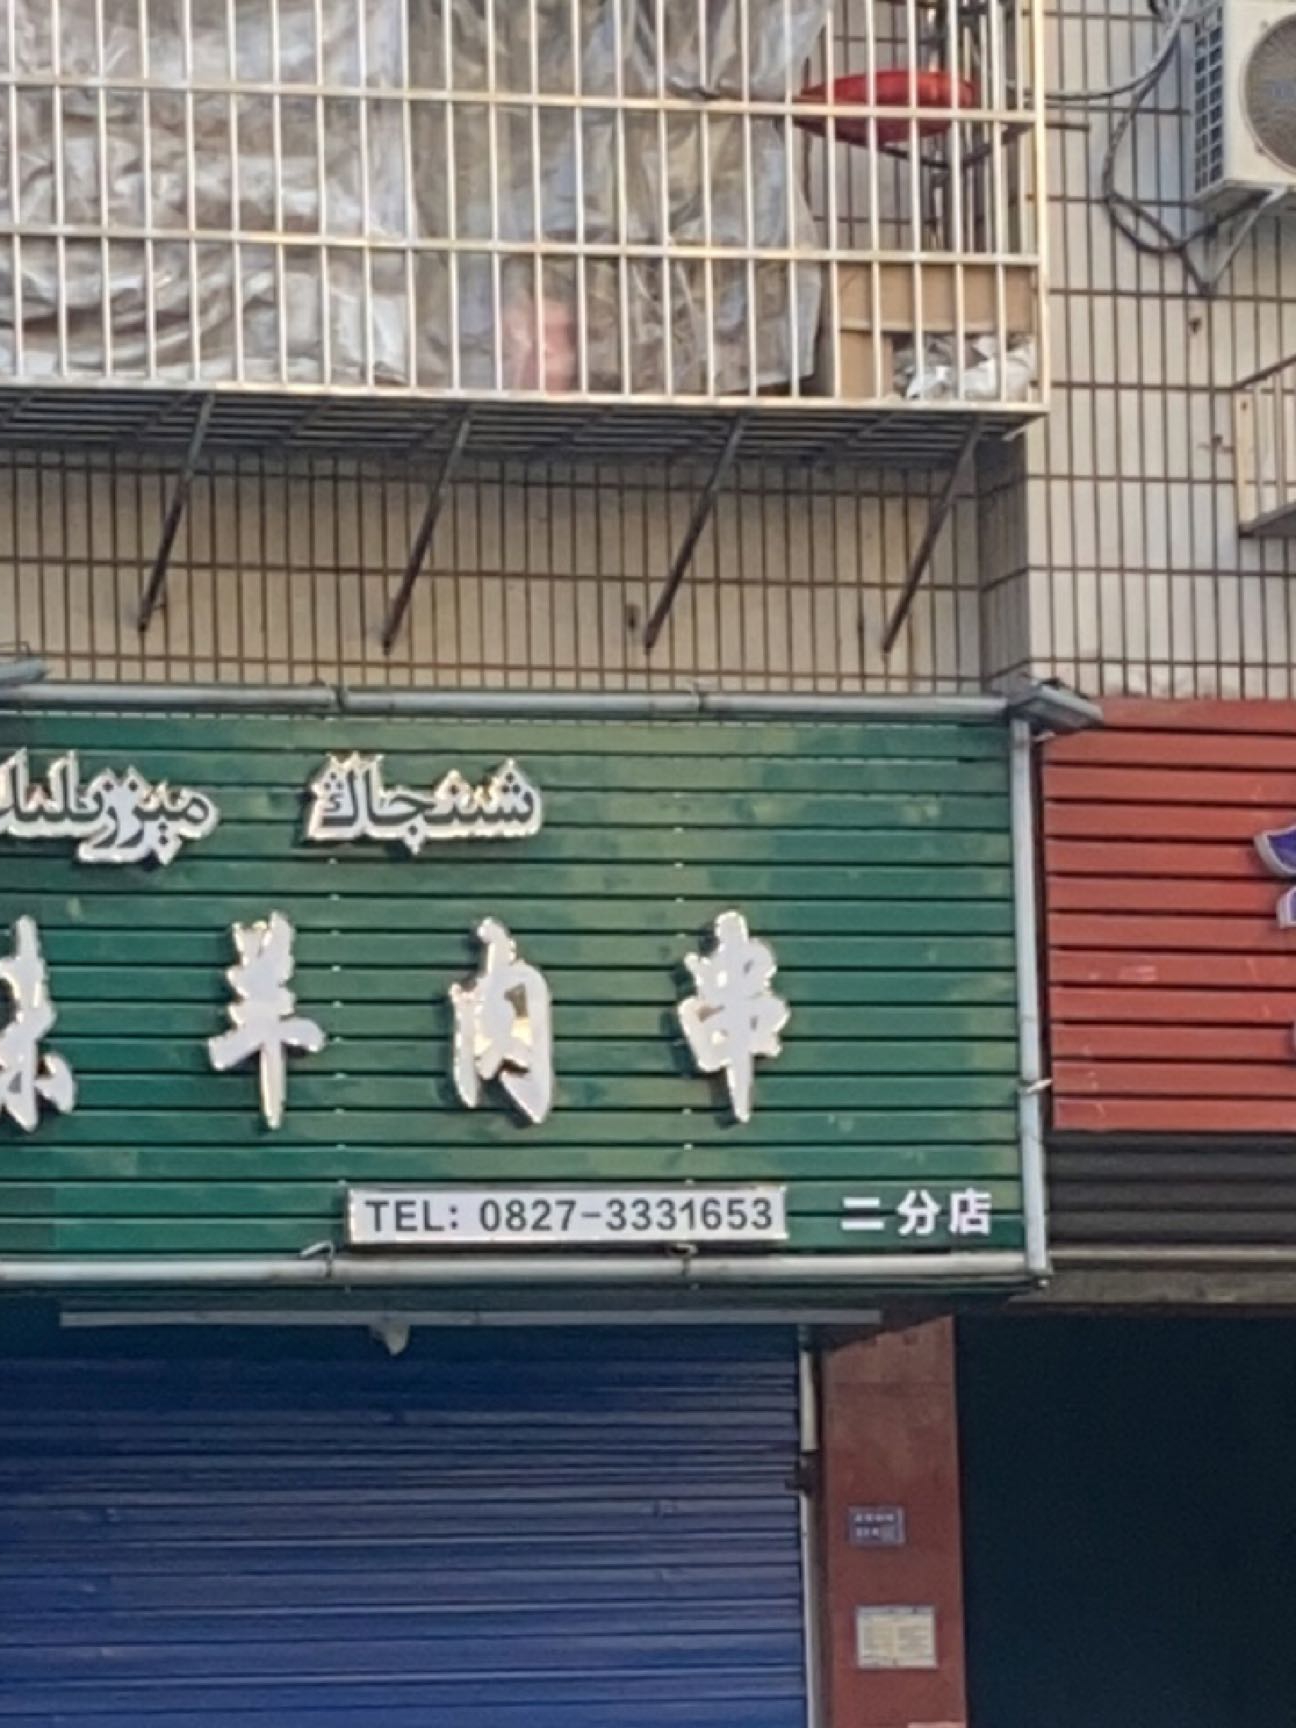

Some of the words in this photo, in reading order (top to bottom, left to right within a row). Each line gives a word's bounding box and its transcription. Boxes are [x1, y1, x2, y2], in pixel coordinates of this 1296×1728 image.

[365, 1198, 460, 1233] TEL:
[478, 1196, 773, 1233] 0827-3331653
[841, 1189, 992, 1236] 二分店
